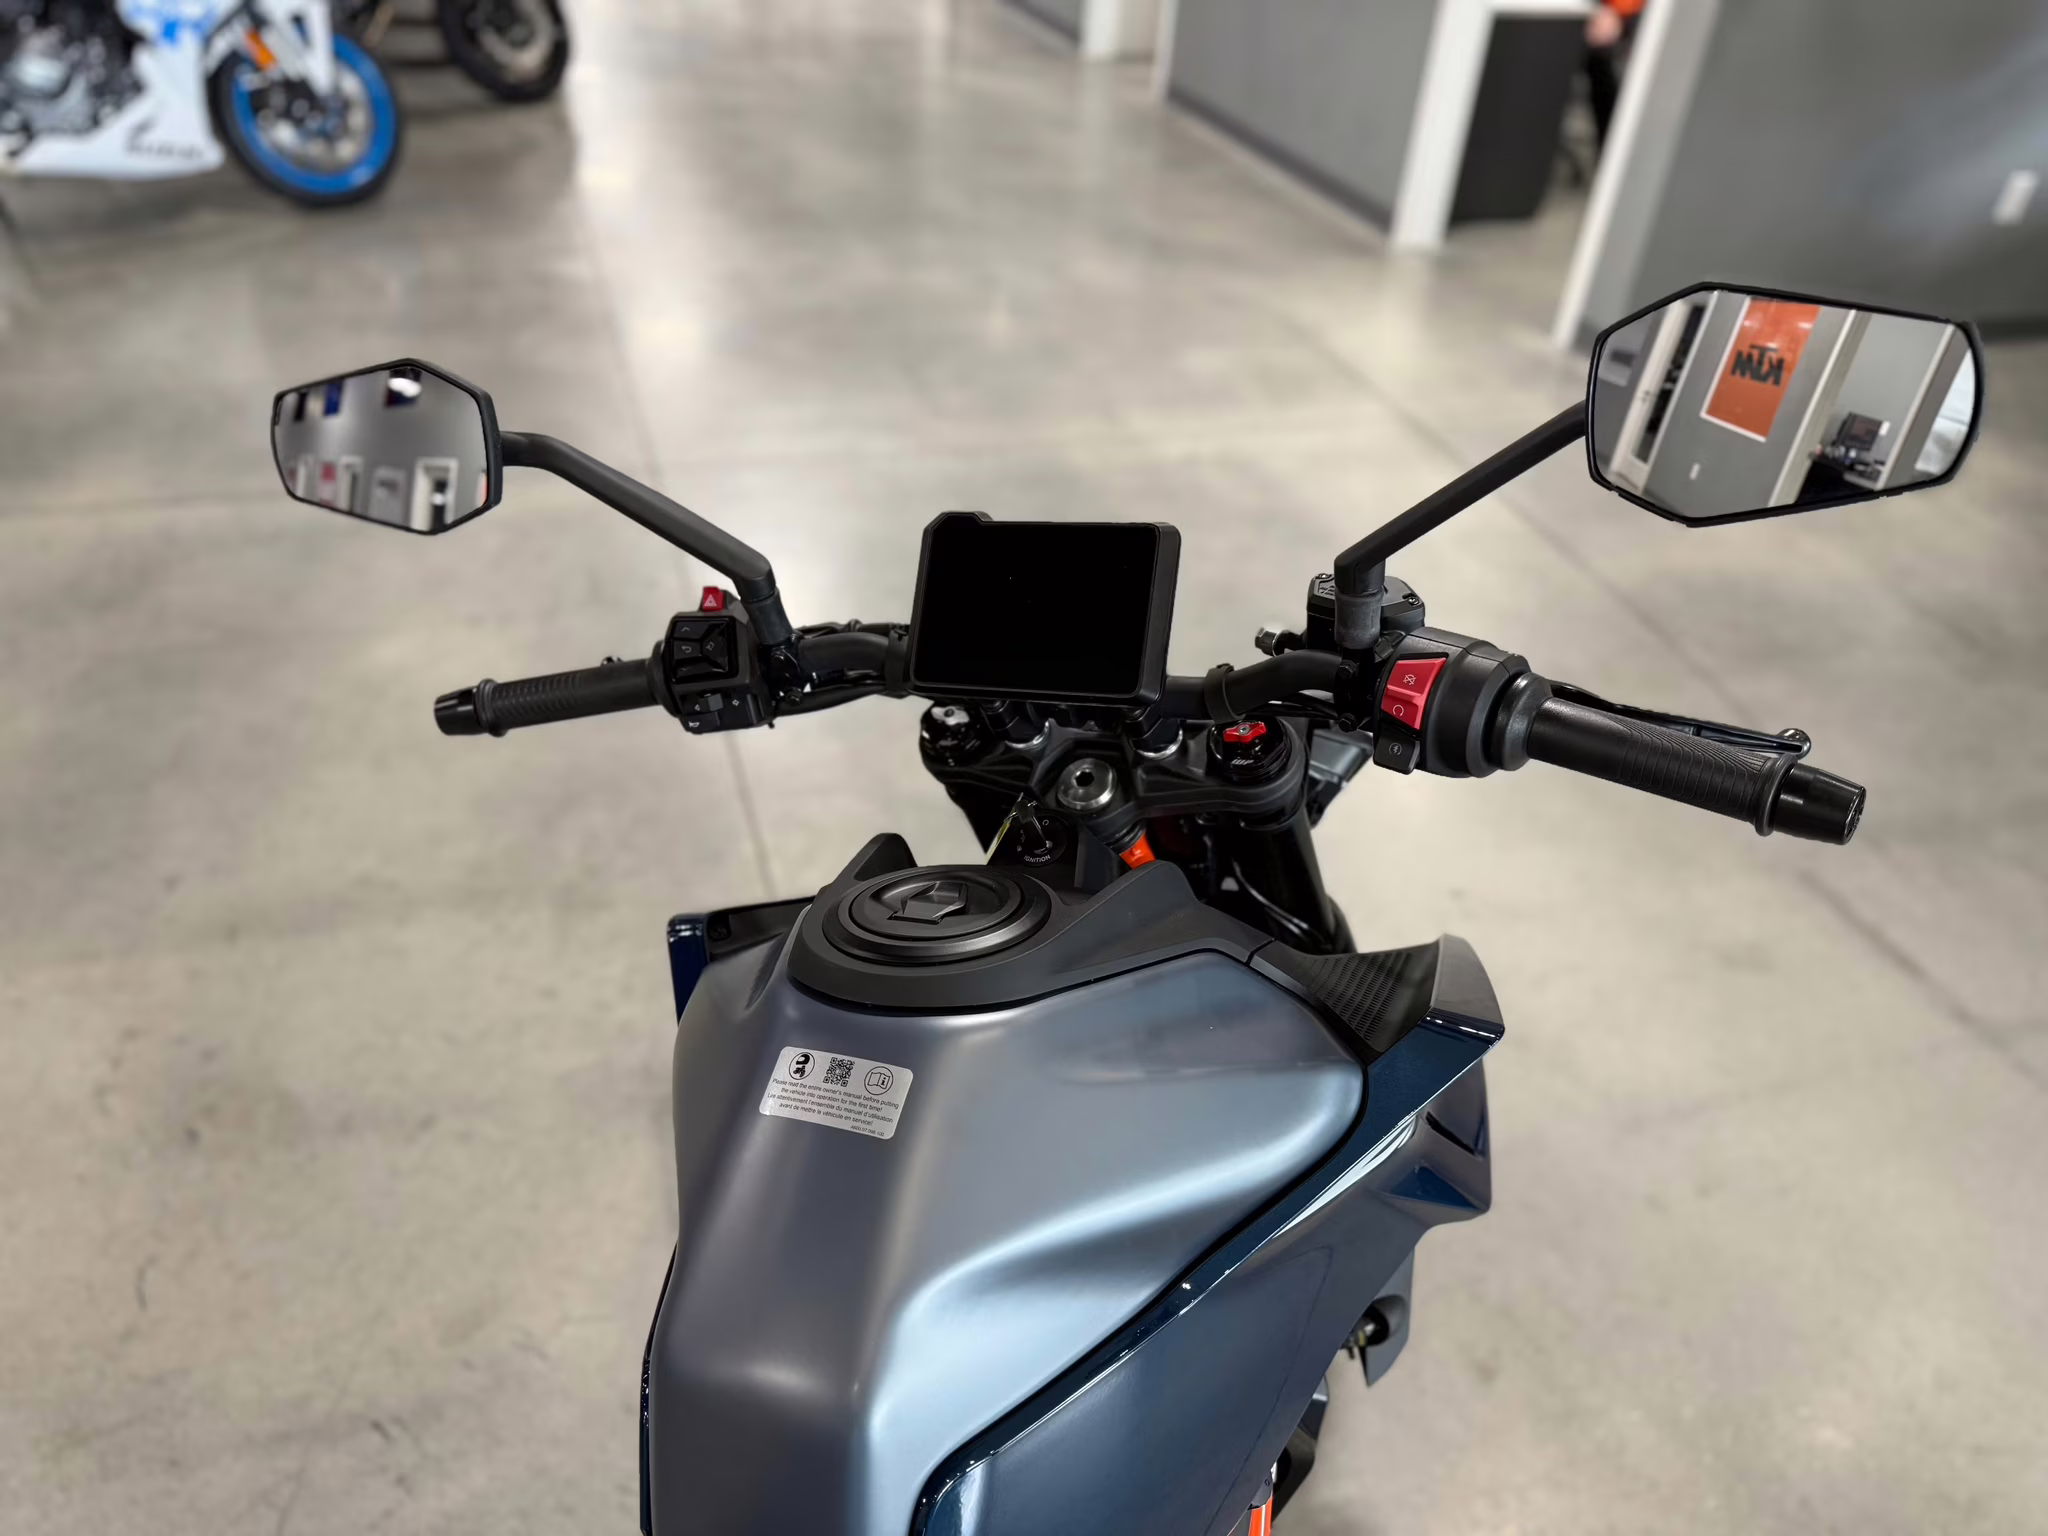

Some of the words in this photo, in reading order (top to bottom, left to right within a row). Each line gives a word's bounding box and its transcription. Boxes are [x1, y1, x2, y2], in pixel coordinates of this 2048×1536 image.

[1023, 854, 1051, 863] IGNITION
[772, 1077, 788, 1086] Please
[822, 1087, 842, 1096] owner's
[843, 1091, 863, 1100] manual
[862, 1095, 880, 1104] before
[880, 1100, 900, 1110] putting
[789, 1089, 806, 1097] vehicle
[816, 1094, 840, 1103] operation
[868, 1104, 883, 1112] time!
[800, 1106, 817, 1114] mettre
[843, 1107, 863, 1116] manuel
